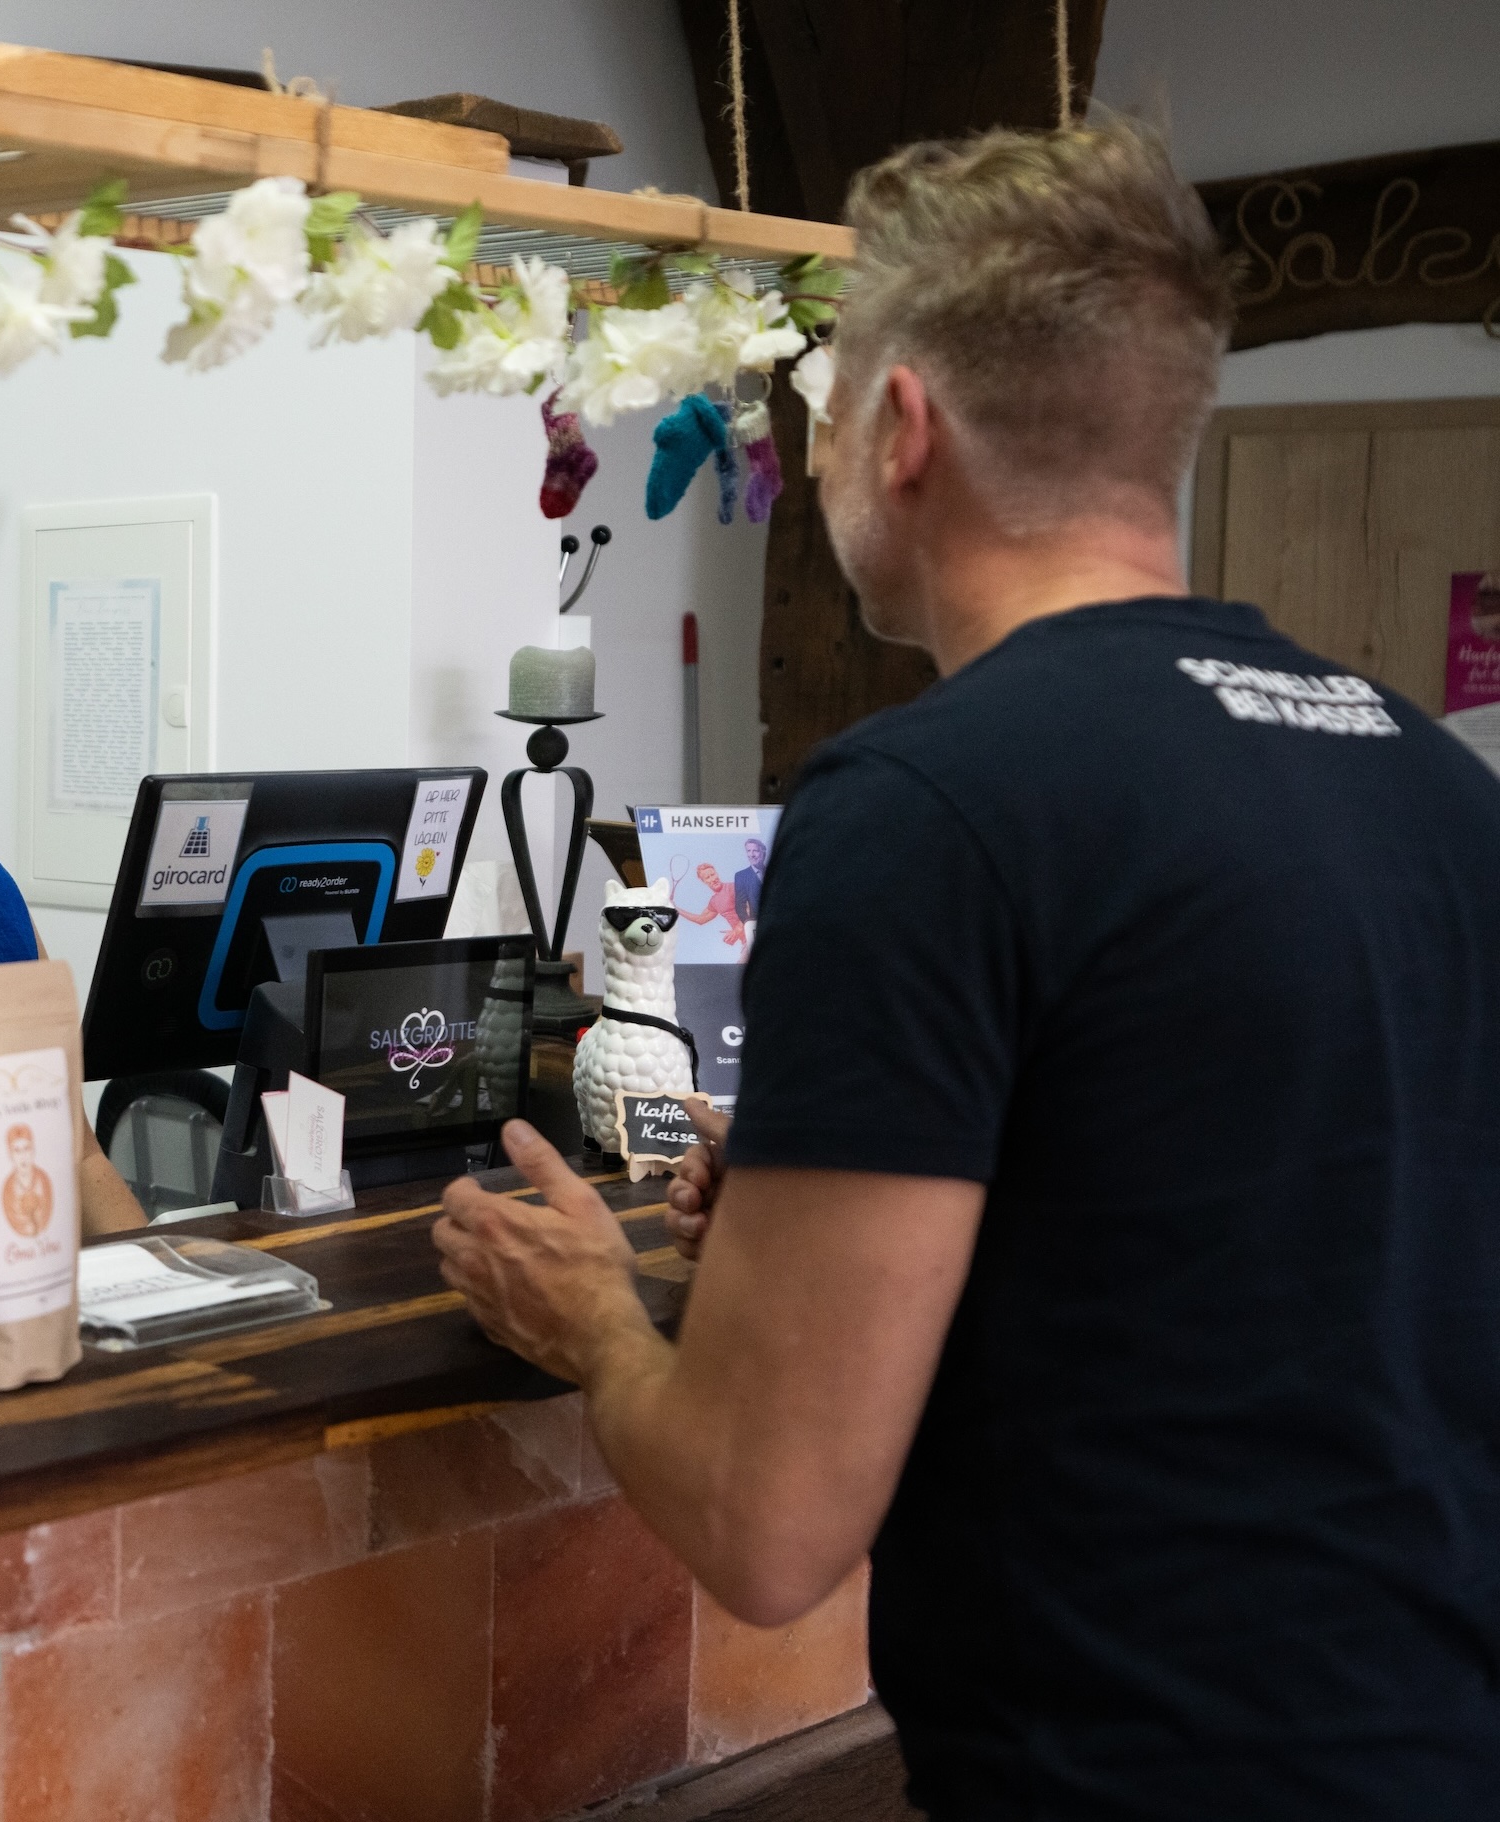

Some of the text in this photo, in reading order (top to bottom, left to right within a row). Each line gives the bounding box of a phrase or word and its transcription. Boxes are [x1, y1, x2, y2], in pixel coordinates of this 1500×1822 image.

[671, 815, 750, 829] HANSEFIT
[152, 864, 227, 891] girocard
[299, 876, 348, 889] ready2order
[370, 1021, 477, 1049] SALZGROTTE
[314, 1105, 325, 1172] SALZGROTTE
[642, 1123, 700, 1145] Kasse
